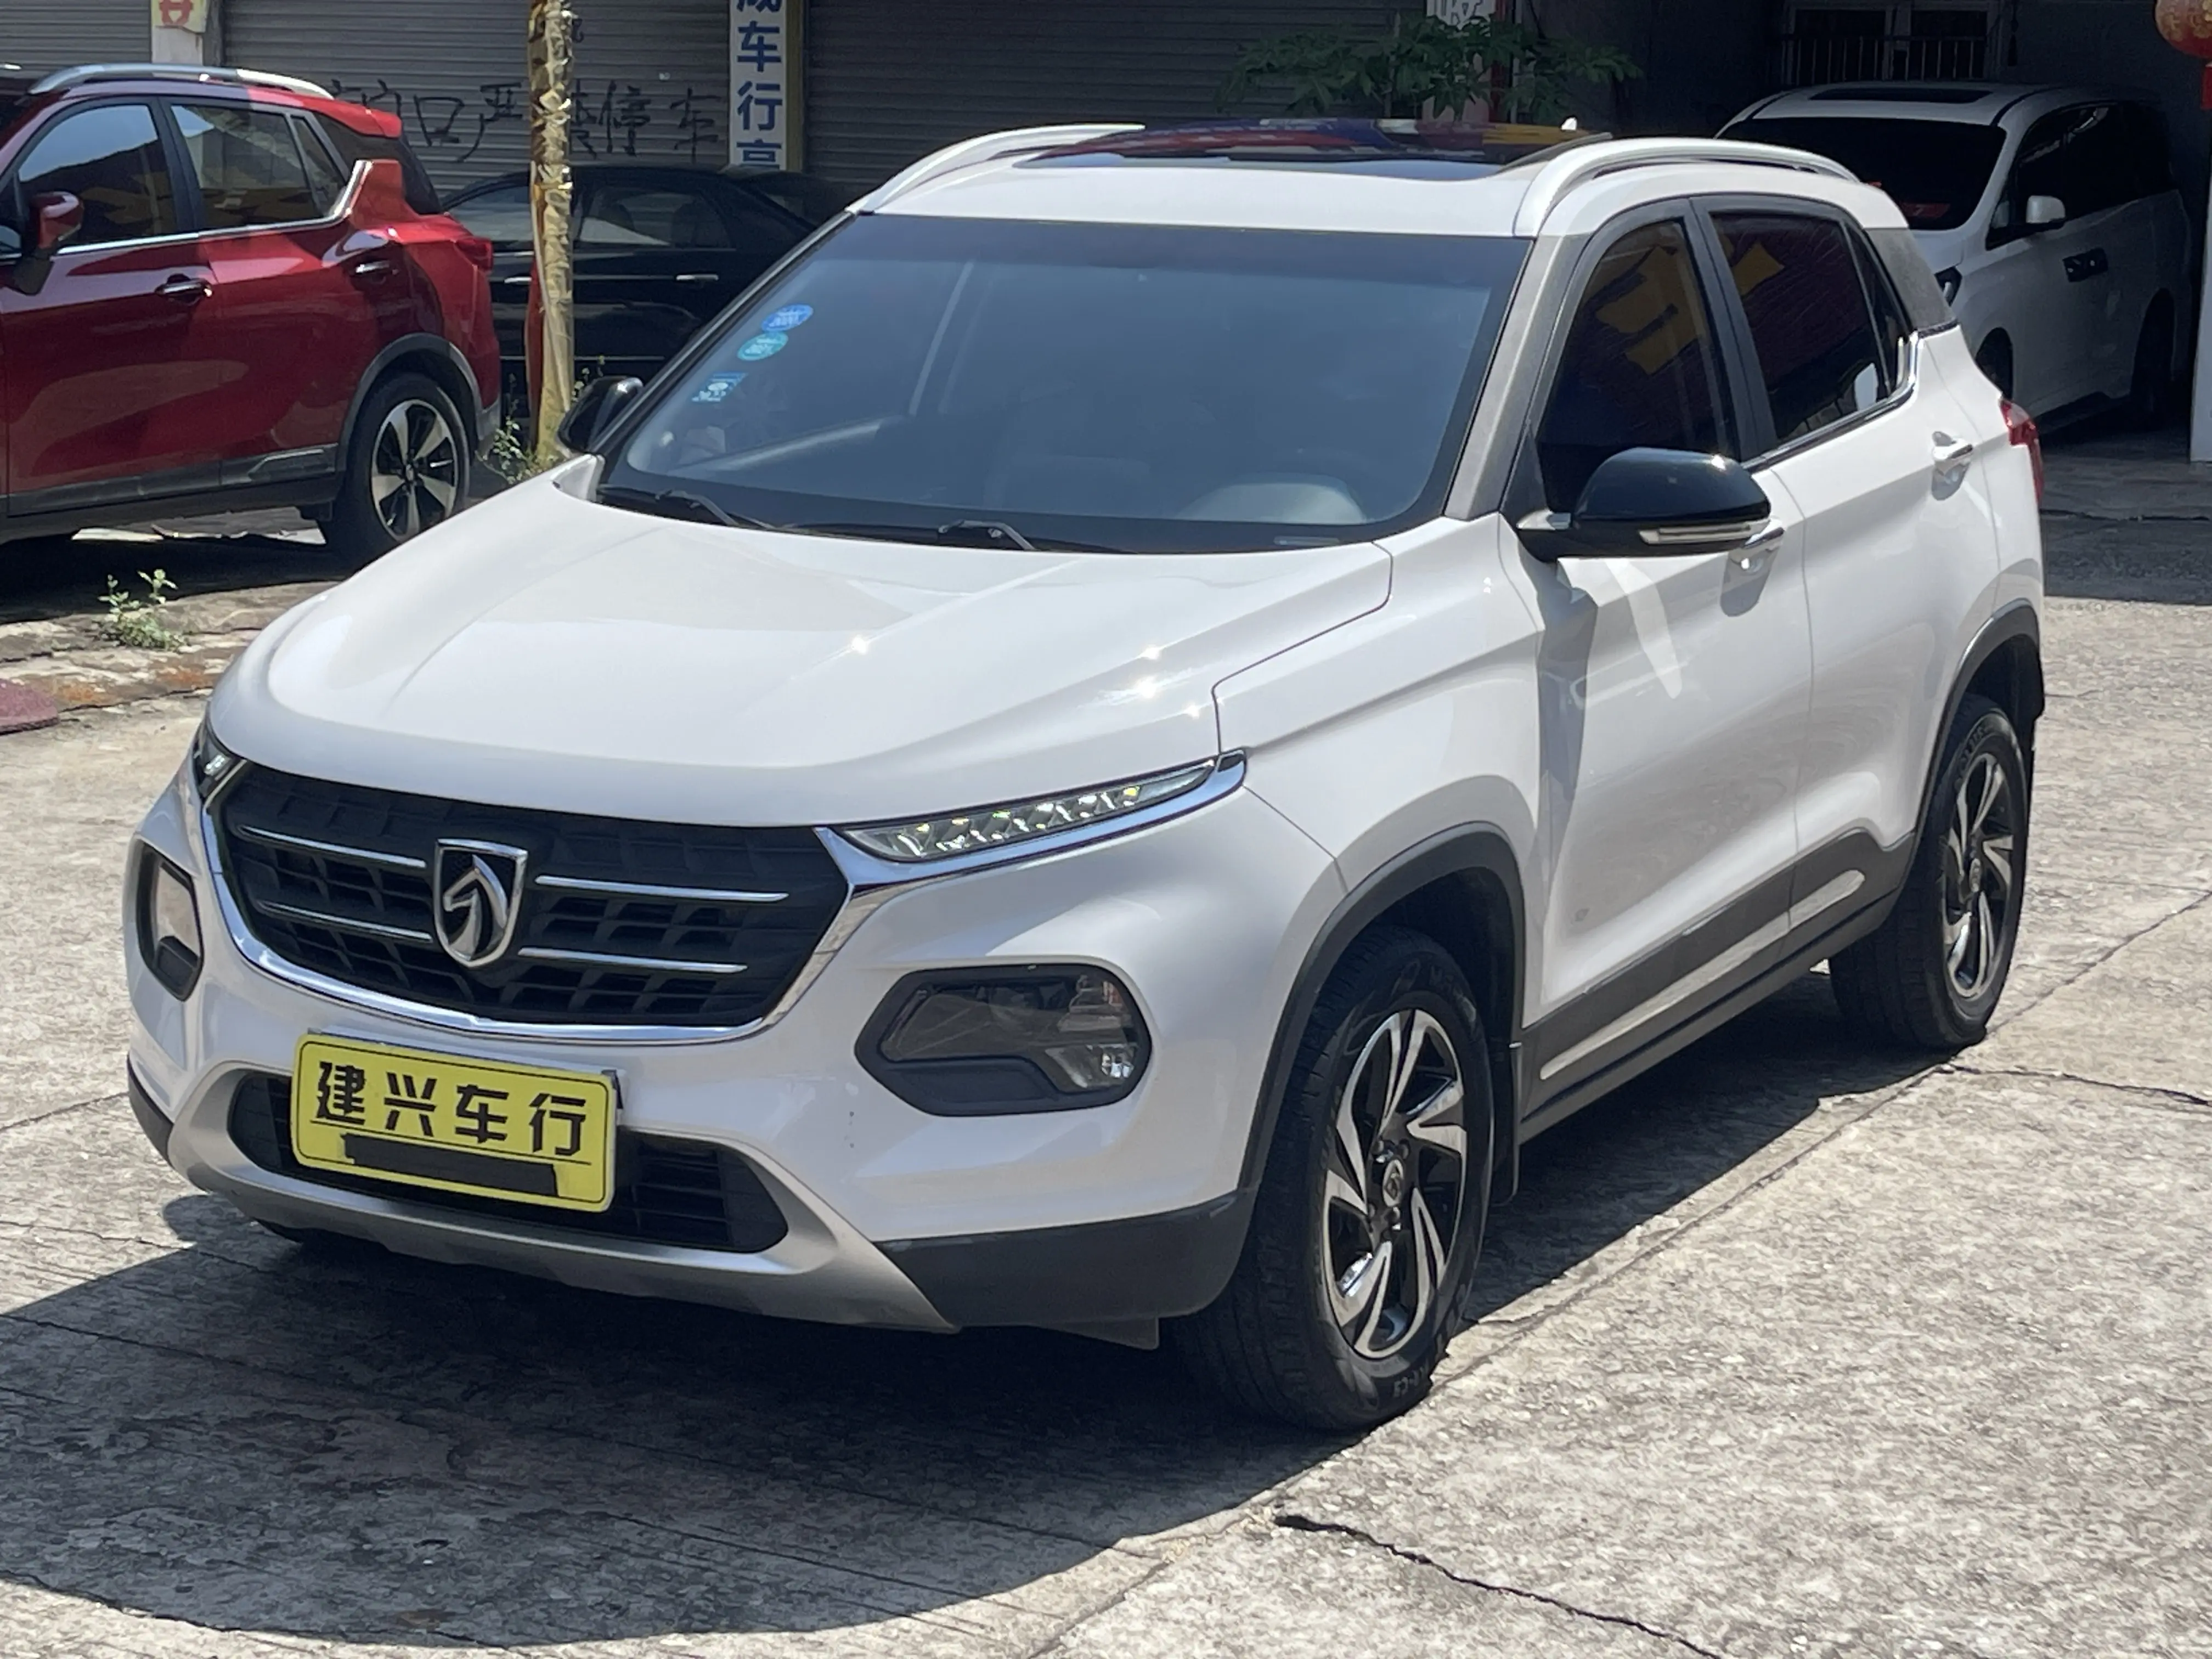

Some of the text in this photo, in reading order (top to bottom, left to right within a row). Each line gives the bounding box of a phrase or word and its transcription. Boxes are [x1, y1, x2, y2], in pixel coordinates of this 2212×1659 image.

[736, 0, 783, 169] 车行高
[317, 1060, 586, 1156] 建兴车行
